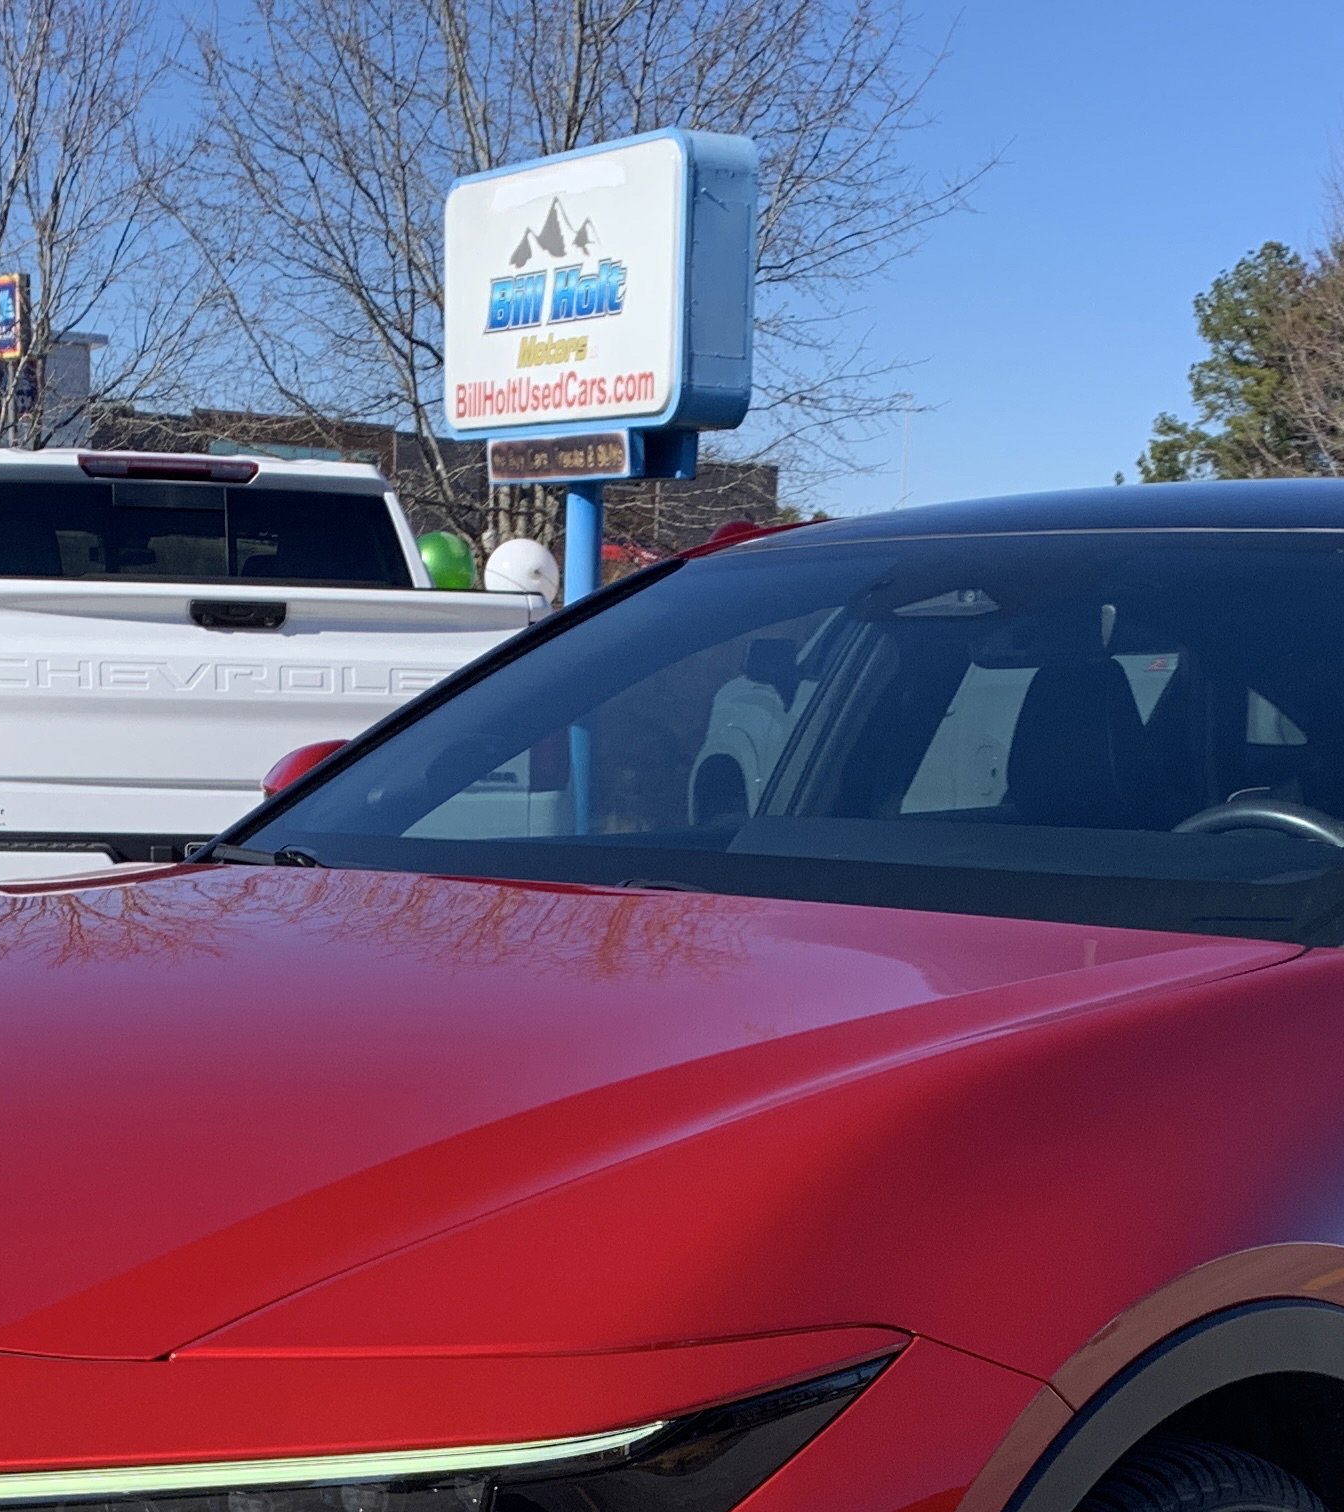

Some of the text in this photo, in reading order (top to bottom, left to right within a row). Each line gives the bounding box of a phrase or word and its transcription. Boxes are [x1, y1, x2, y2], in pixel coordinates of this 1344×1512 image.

[483, 258, 628, 335] Bill Holt
[517, 333, 589, 368] Motors
[456, 370, 655, 419] BillHoltUsedCars.com
